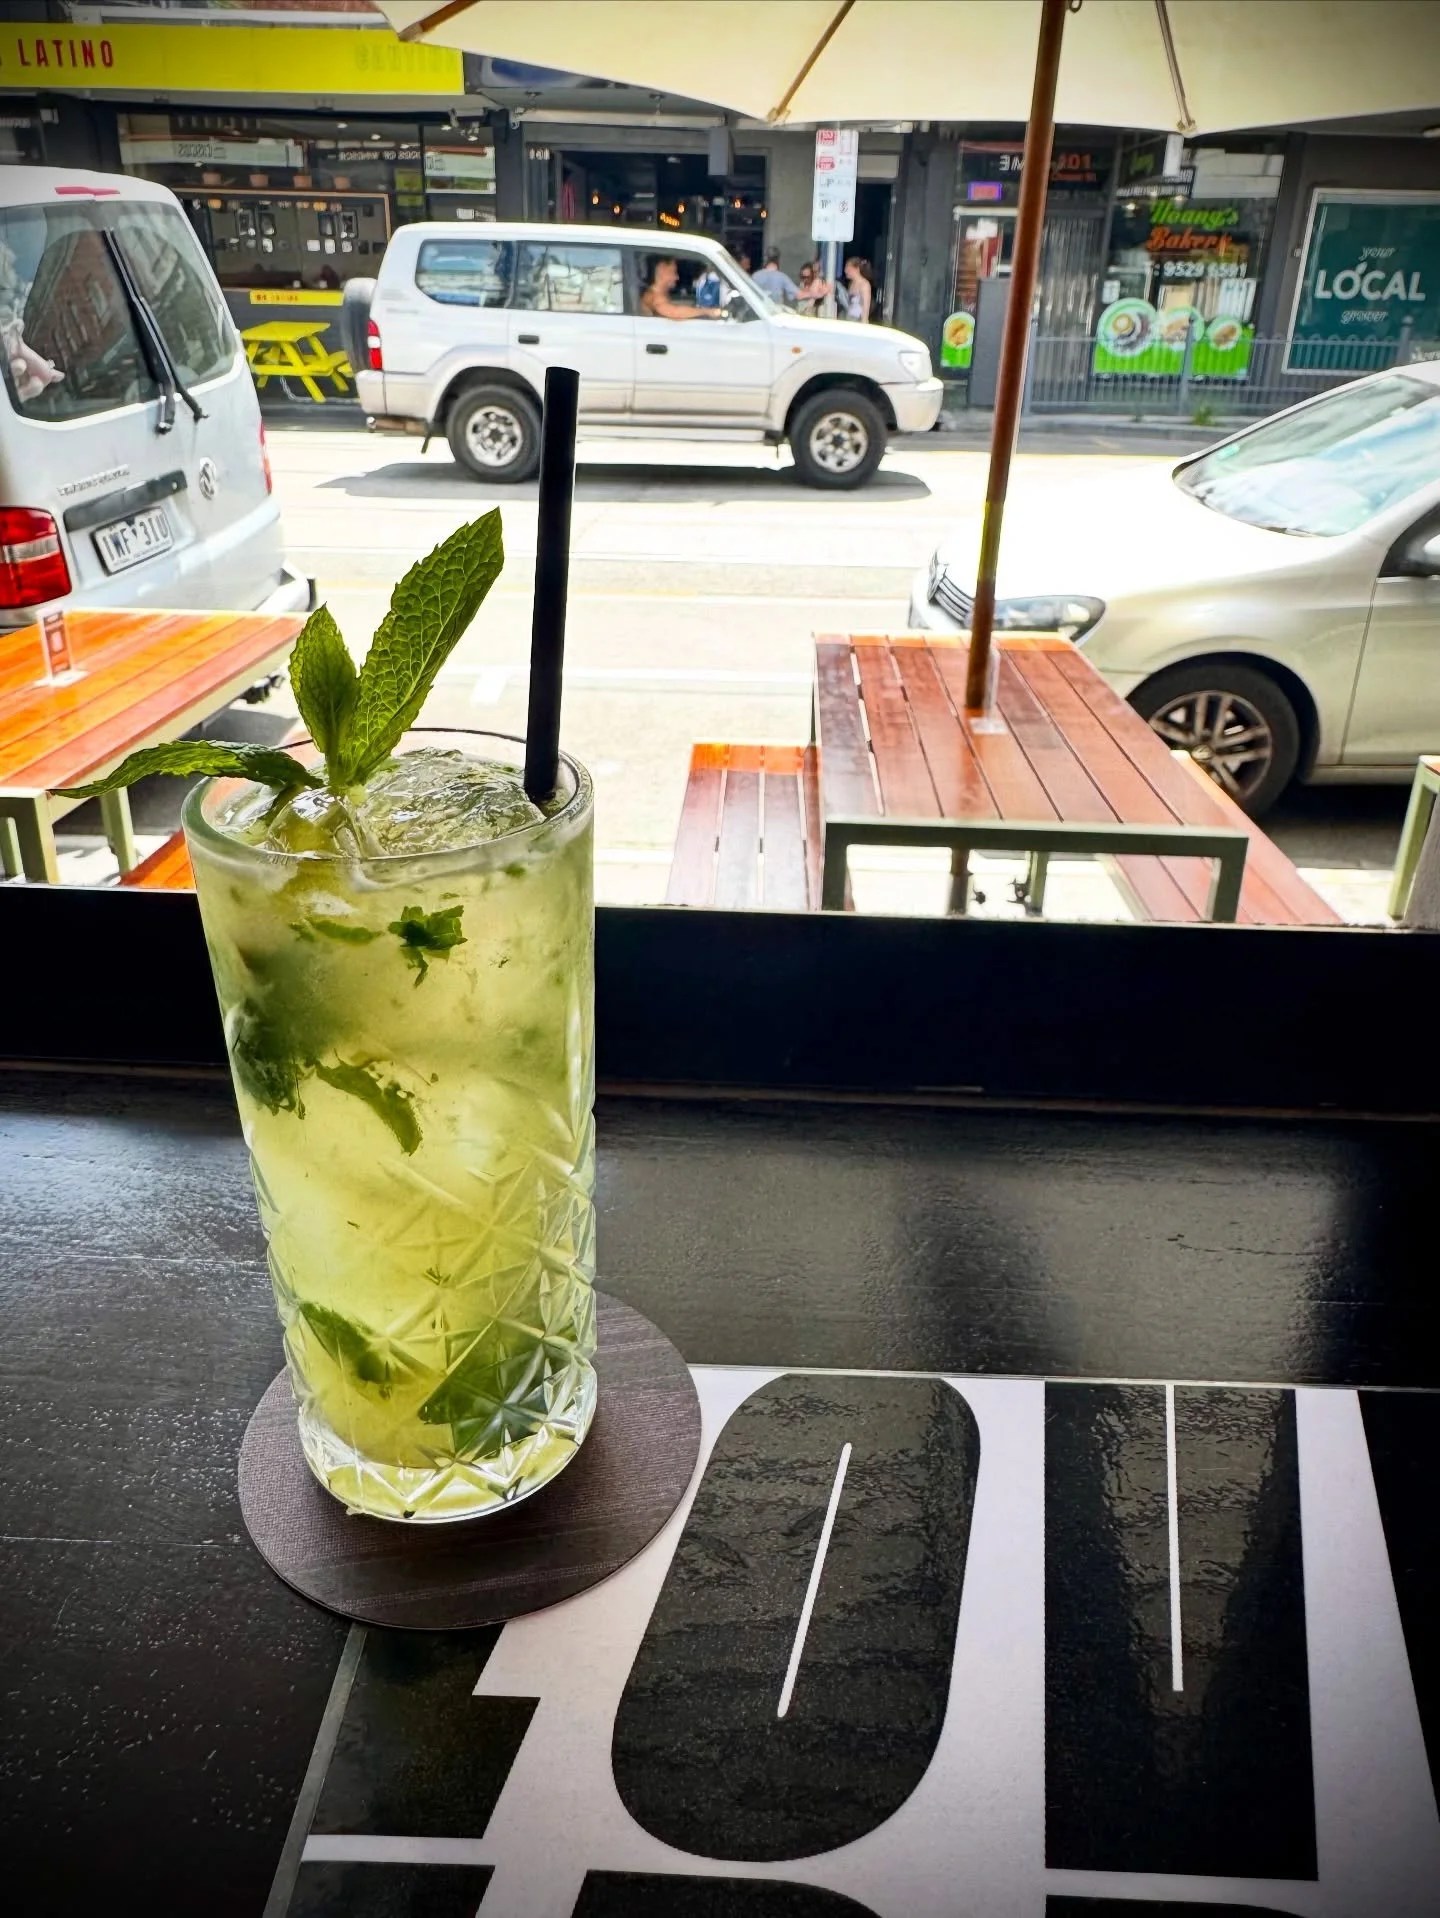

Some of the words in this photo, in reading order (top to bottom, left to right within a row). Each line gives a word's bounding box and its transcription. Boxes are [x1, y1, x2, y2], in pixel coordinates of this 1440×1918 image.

[17, 38, 114, 68] LATINO
[1146, 226, 1232, 254] Bakery
[1314, 268, 1426, 301] LOCAL
